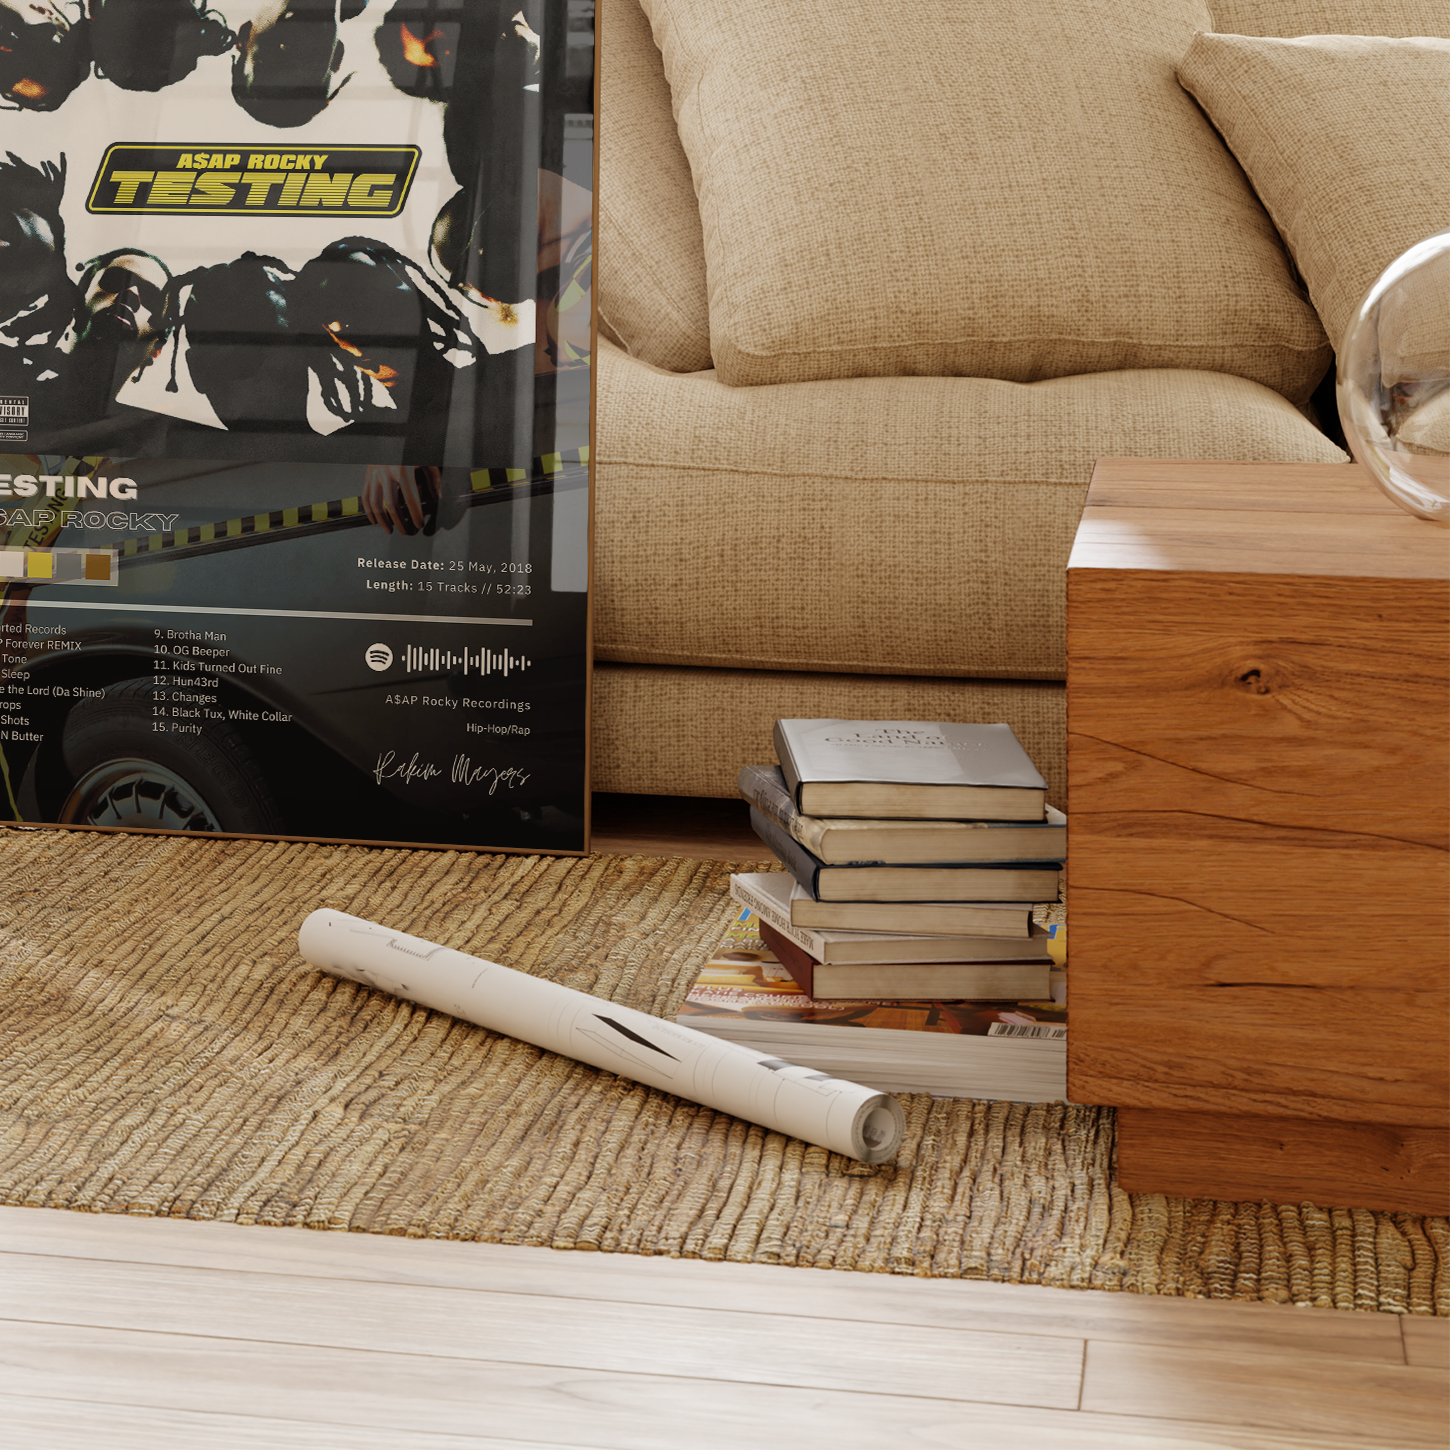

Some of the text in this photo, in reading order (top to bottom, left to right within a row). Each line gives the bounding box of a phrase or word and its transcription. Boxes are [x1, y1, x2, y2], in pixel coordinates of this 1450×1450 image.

[176, 153, 328, 170] A$AP ROCKY
[109, 170, 397, 207] TESTING
[61, 510, 179, 531] ROCKY
[358, 558, 532, 574] Release Date: 25 May, 2018
[366, 579, 532, 595] Length: 15 Tracks // 52:23
[25, 624, 67, 635] Records
[154, 629, 227, 641] 9. Brotha Man
[5, 639, 45, 649] Forever
[47, 641, 82, 651] REMIX
[154, 645, 230, 659] 10. OG Beeper
[2, 654, 27, 664] Tone
[153, 660, 283, 674] 11. Kids Turned Out Fine
[1, 670, 30, 681] Sleep
[153, 676, 219, 688] 12. Hun43rd
[8, 685, 24, 694] the
[27, 685, 49, 696] Lord
[53, 686, 70, 698] (Da
[73, 687, 106, 699] Shine)
[152, 691, 217, 705] 13. Changes
[385, 694, 531, 712] A$AP Rocky Recordings
[1, 715, 30, 725] Shots
[152, 707, 292, 722] 14. Black Tux, White Collar
[1, 731, 8, 740] N
[12, 731, 44, 741] Butter
[152, 722, 202, 736] 15. Purity
[467, 723, 531, 736] Hip-Hop/Rap
